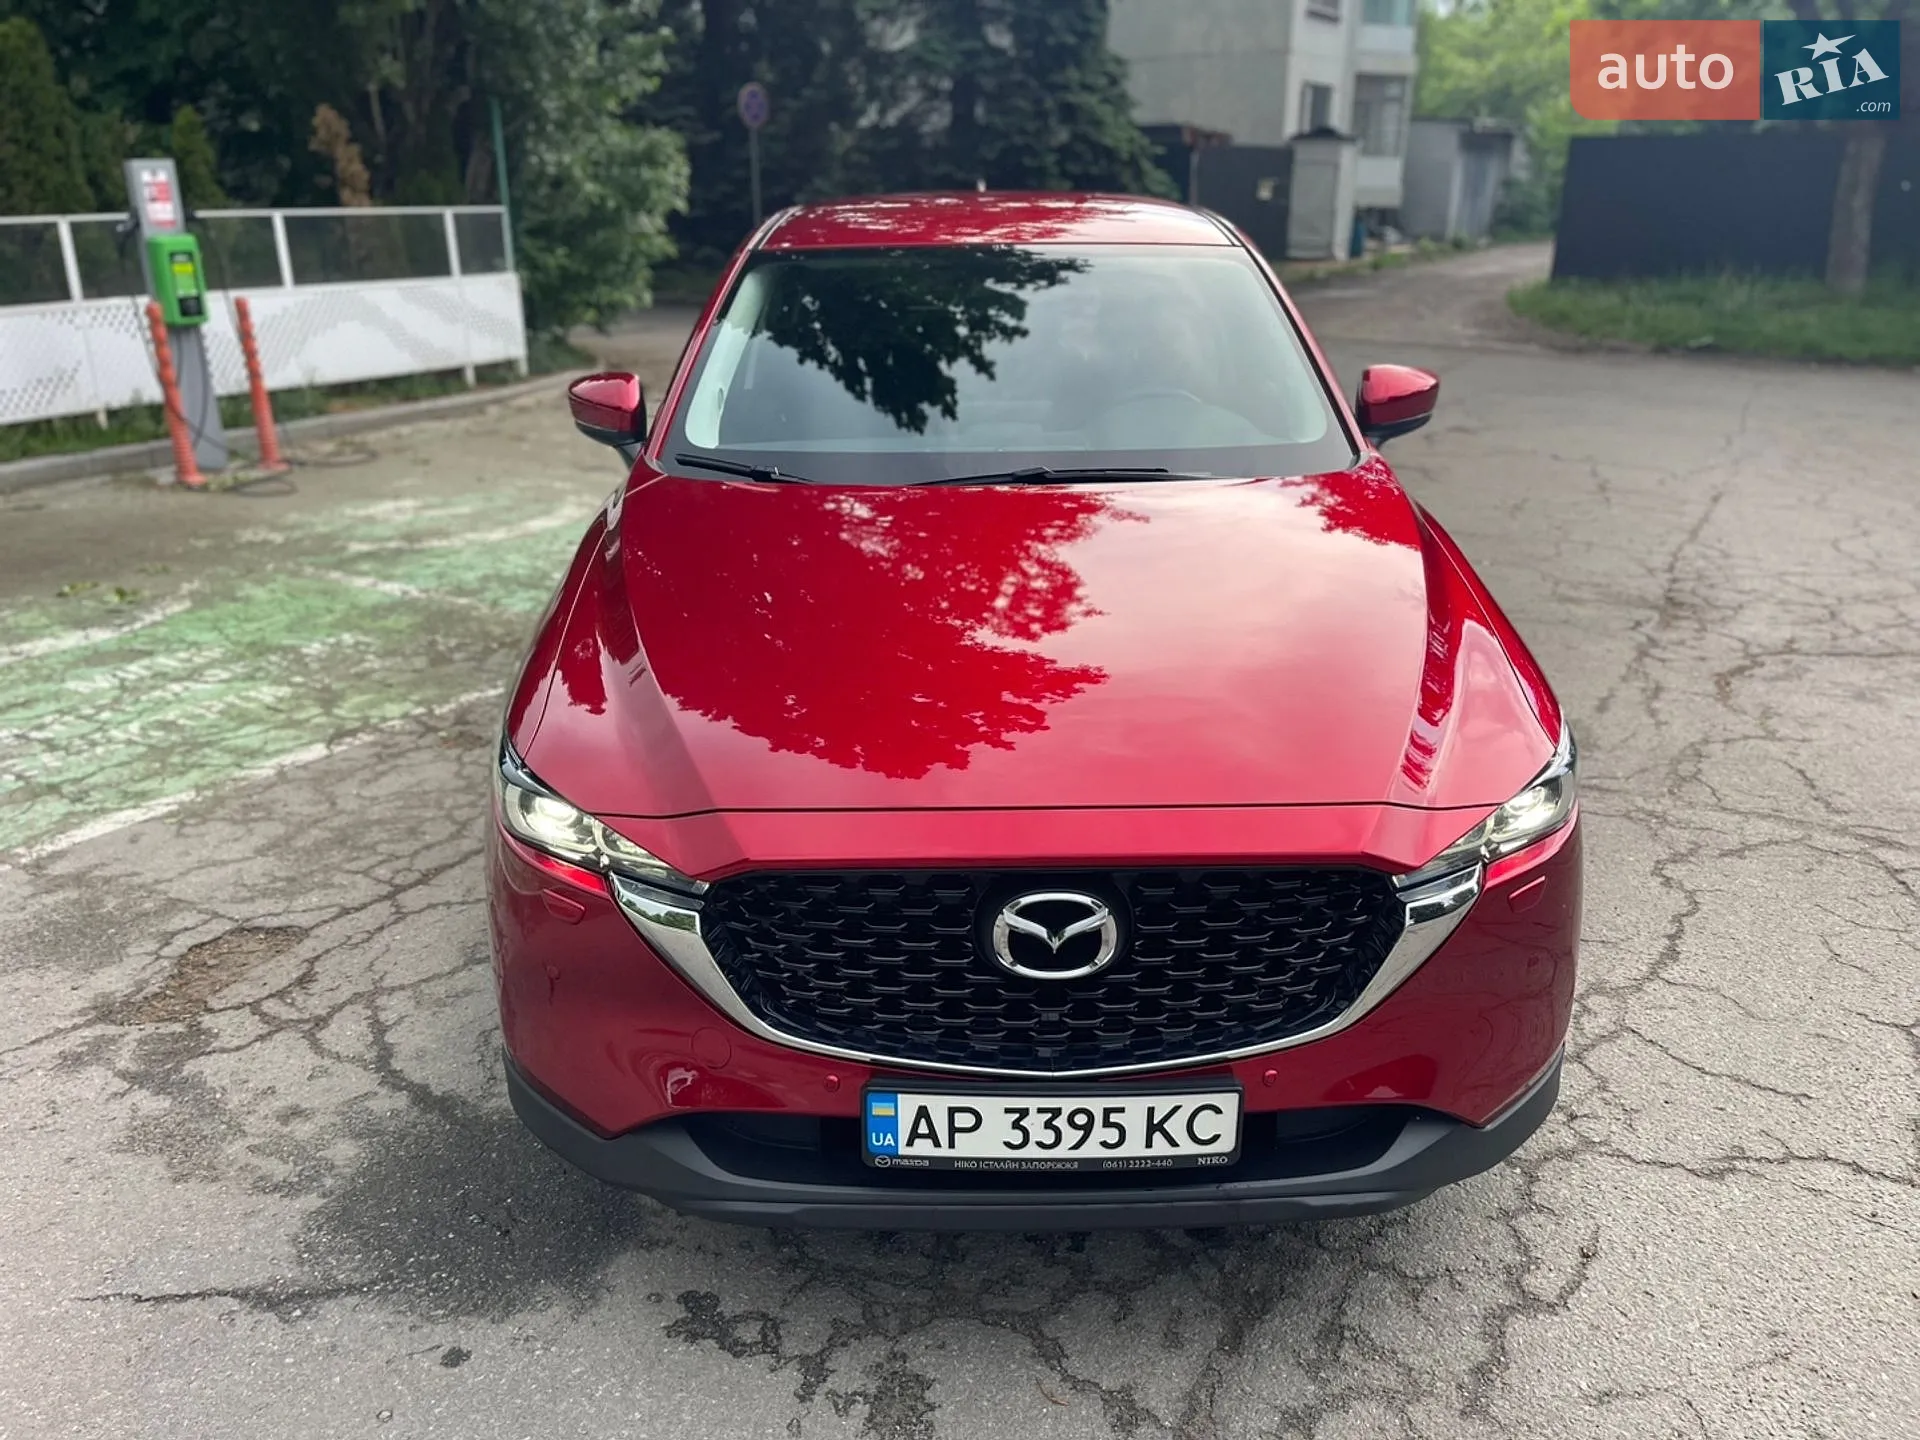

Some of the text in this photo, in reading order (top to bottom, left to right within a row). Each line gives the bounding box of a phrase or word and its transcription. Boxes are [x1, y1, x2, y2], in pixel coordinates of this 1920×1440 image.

[905, 1103, 1225, 1151] AP 3395 KC
[871, 1133, 896, 1147] UA
[1196, 1155, 1229, 1166] NIKO
